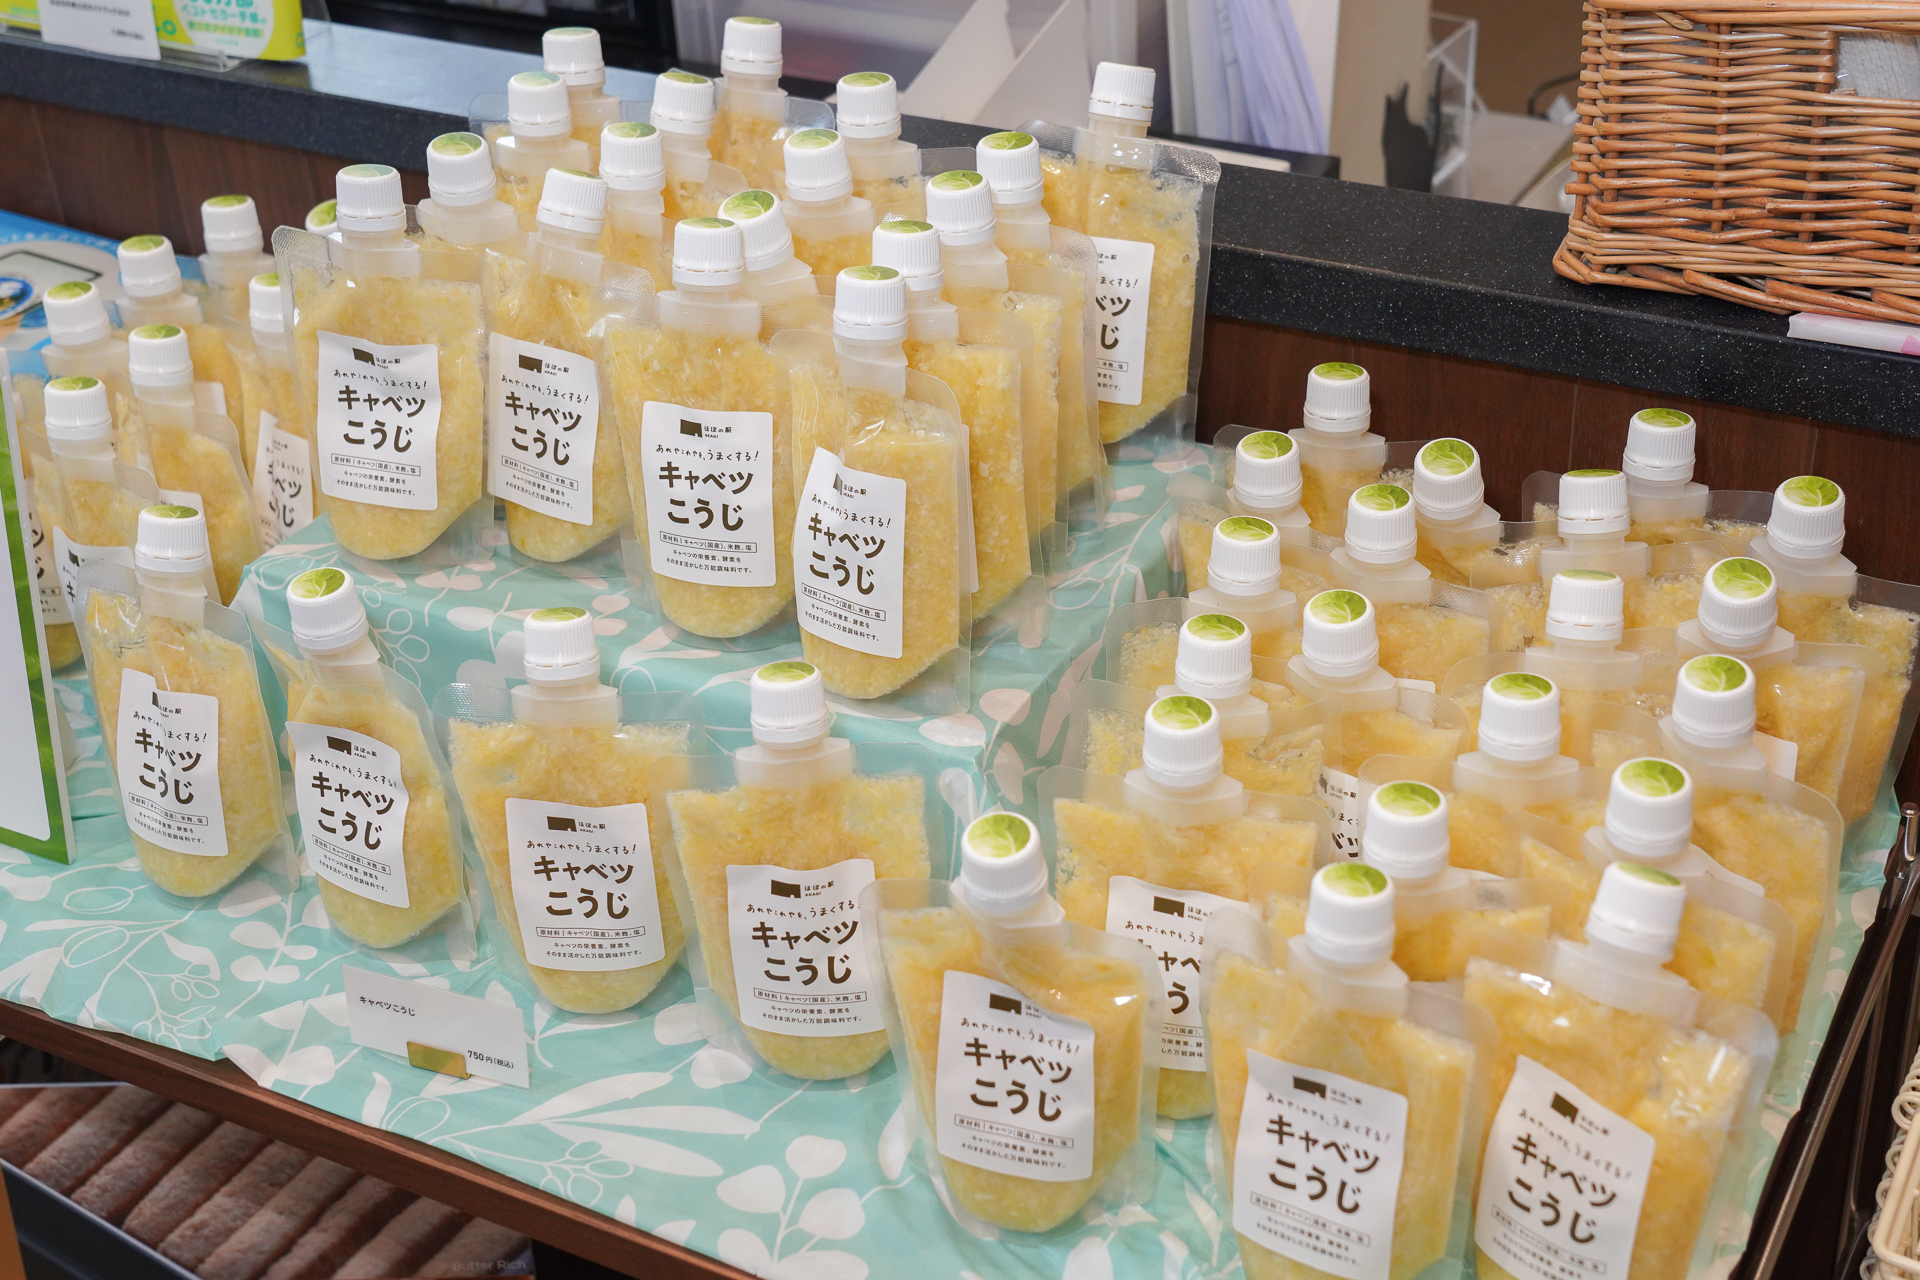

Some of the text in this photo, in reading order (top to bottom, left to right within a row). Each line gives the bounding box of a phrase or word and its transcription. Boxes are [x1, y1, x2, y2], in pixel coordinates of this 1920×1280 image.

[338, 385, 426, 418] キャベツ
[505, 392, 582, 432] キャベツ
[343, 420, 412, 452] こうじ
[511, 426, 570, 466] こうじ
[659, 461, 754, 495] キャベツ
[667, 498, 744, 531] こうじ
[808, 513, 886, 559] キャベツ
[809, 551, 875, 595] こうじ
[135, 727, 202, 772] キャベツ
[139, 762, 194, 805] こうじ
[312, 771, 394, 815] キャベツ
[318, 807, 382, 850] こうじ
[533, 856, 634, 884] キャベツ
[546, 888, 629, 919] こうじ
[752, 920, 859, 950] キャベツ
[764, 954, 852, 986] こうじ
[360, 996, 415, 1017] キャベツこうじ
[1167, 982, 1189, 1015] う
[964, 1037, 1072, 1084] キャベツ
[970, 1078, 1062, 1122] こうじ
[1266, 1114, 1379, 1173] キャベツ
[1269, 1157, 1361, 1214] こうじ
[1512, 1133, 1616, 1207] キャベツ
[1508, 1177, 1596, 1244] こうじ
